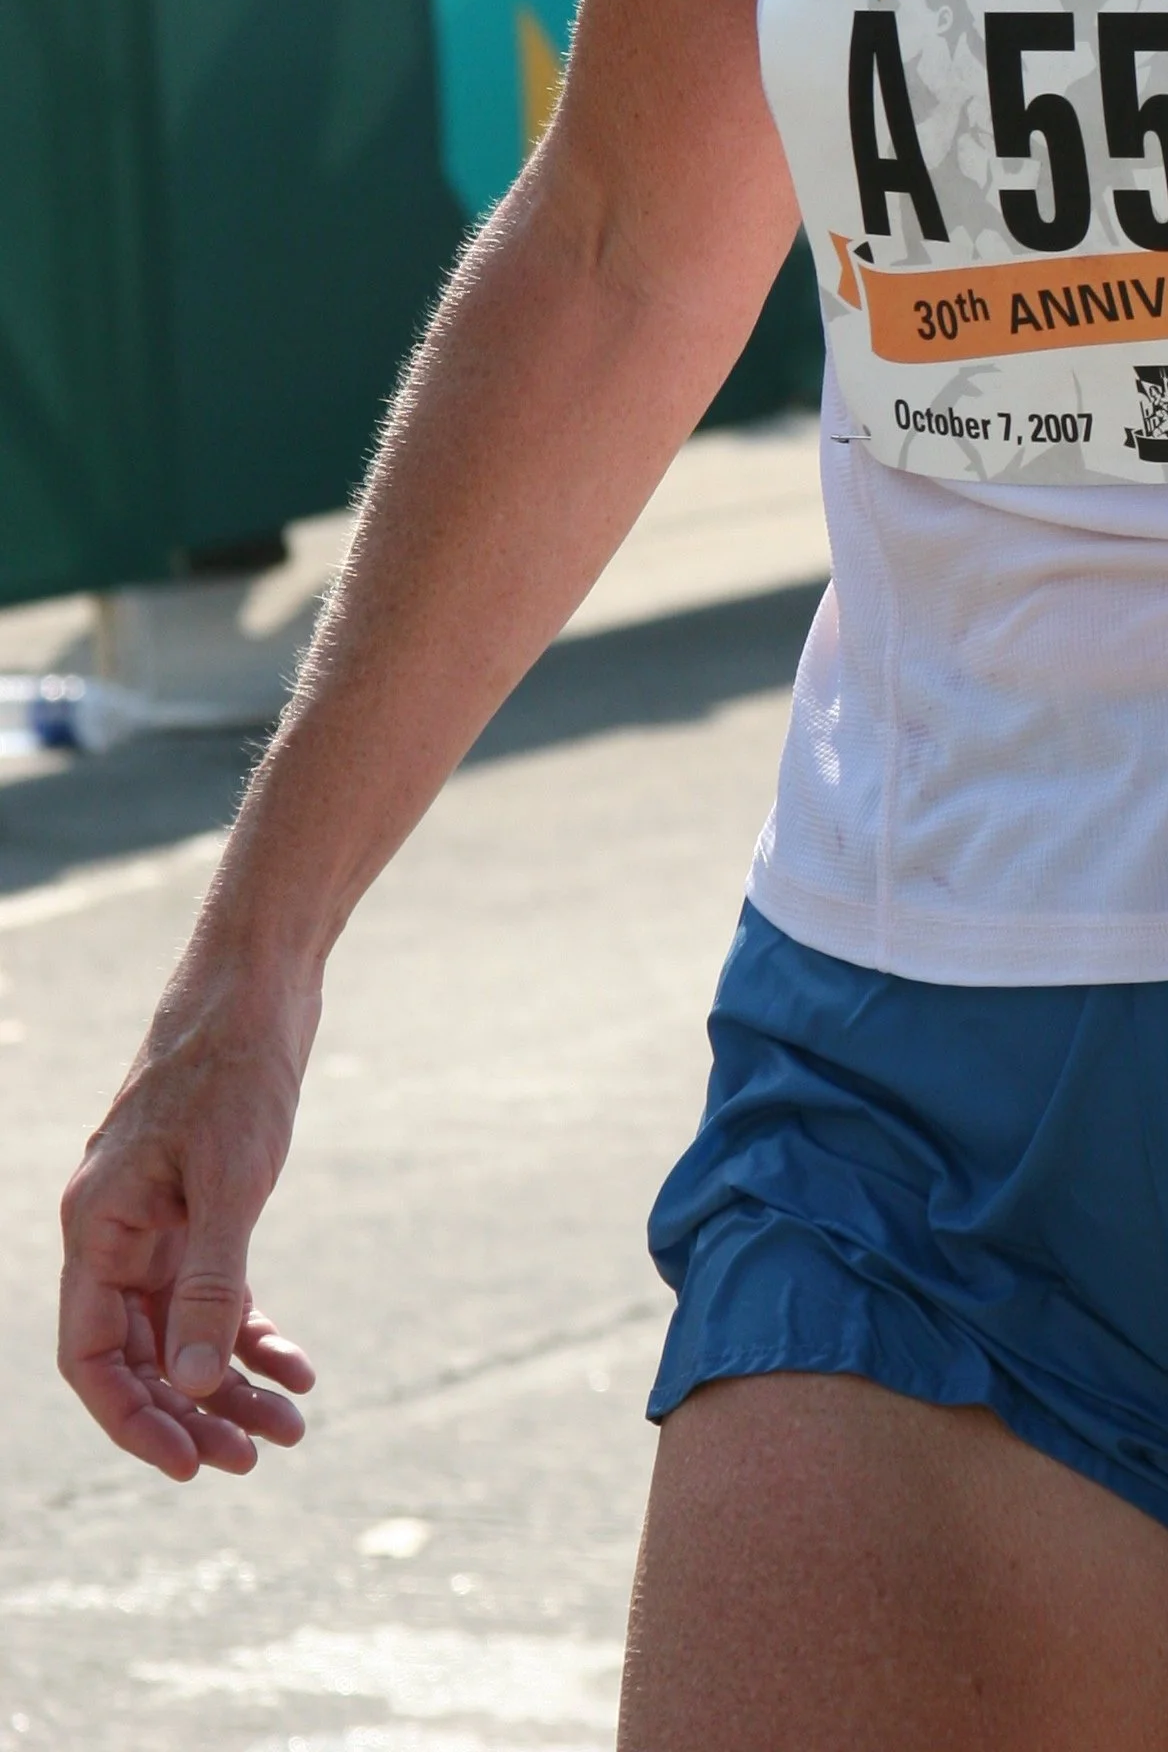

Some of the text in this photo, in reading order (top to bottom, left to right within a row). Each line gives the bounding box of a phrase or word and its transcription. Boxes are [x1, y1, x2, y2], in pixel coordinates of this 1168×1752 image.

[848, 10, 951, 243] A
[913, 288, 991, 341] 30th
[894, 398, 991, 442] October
